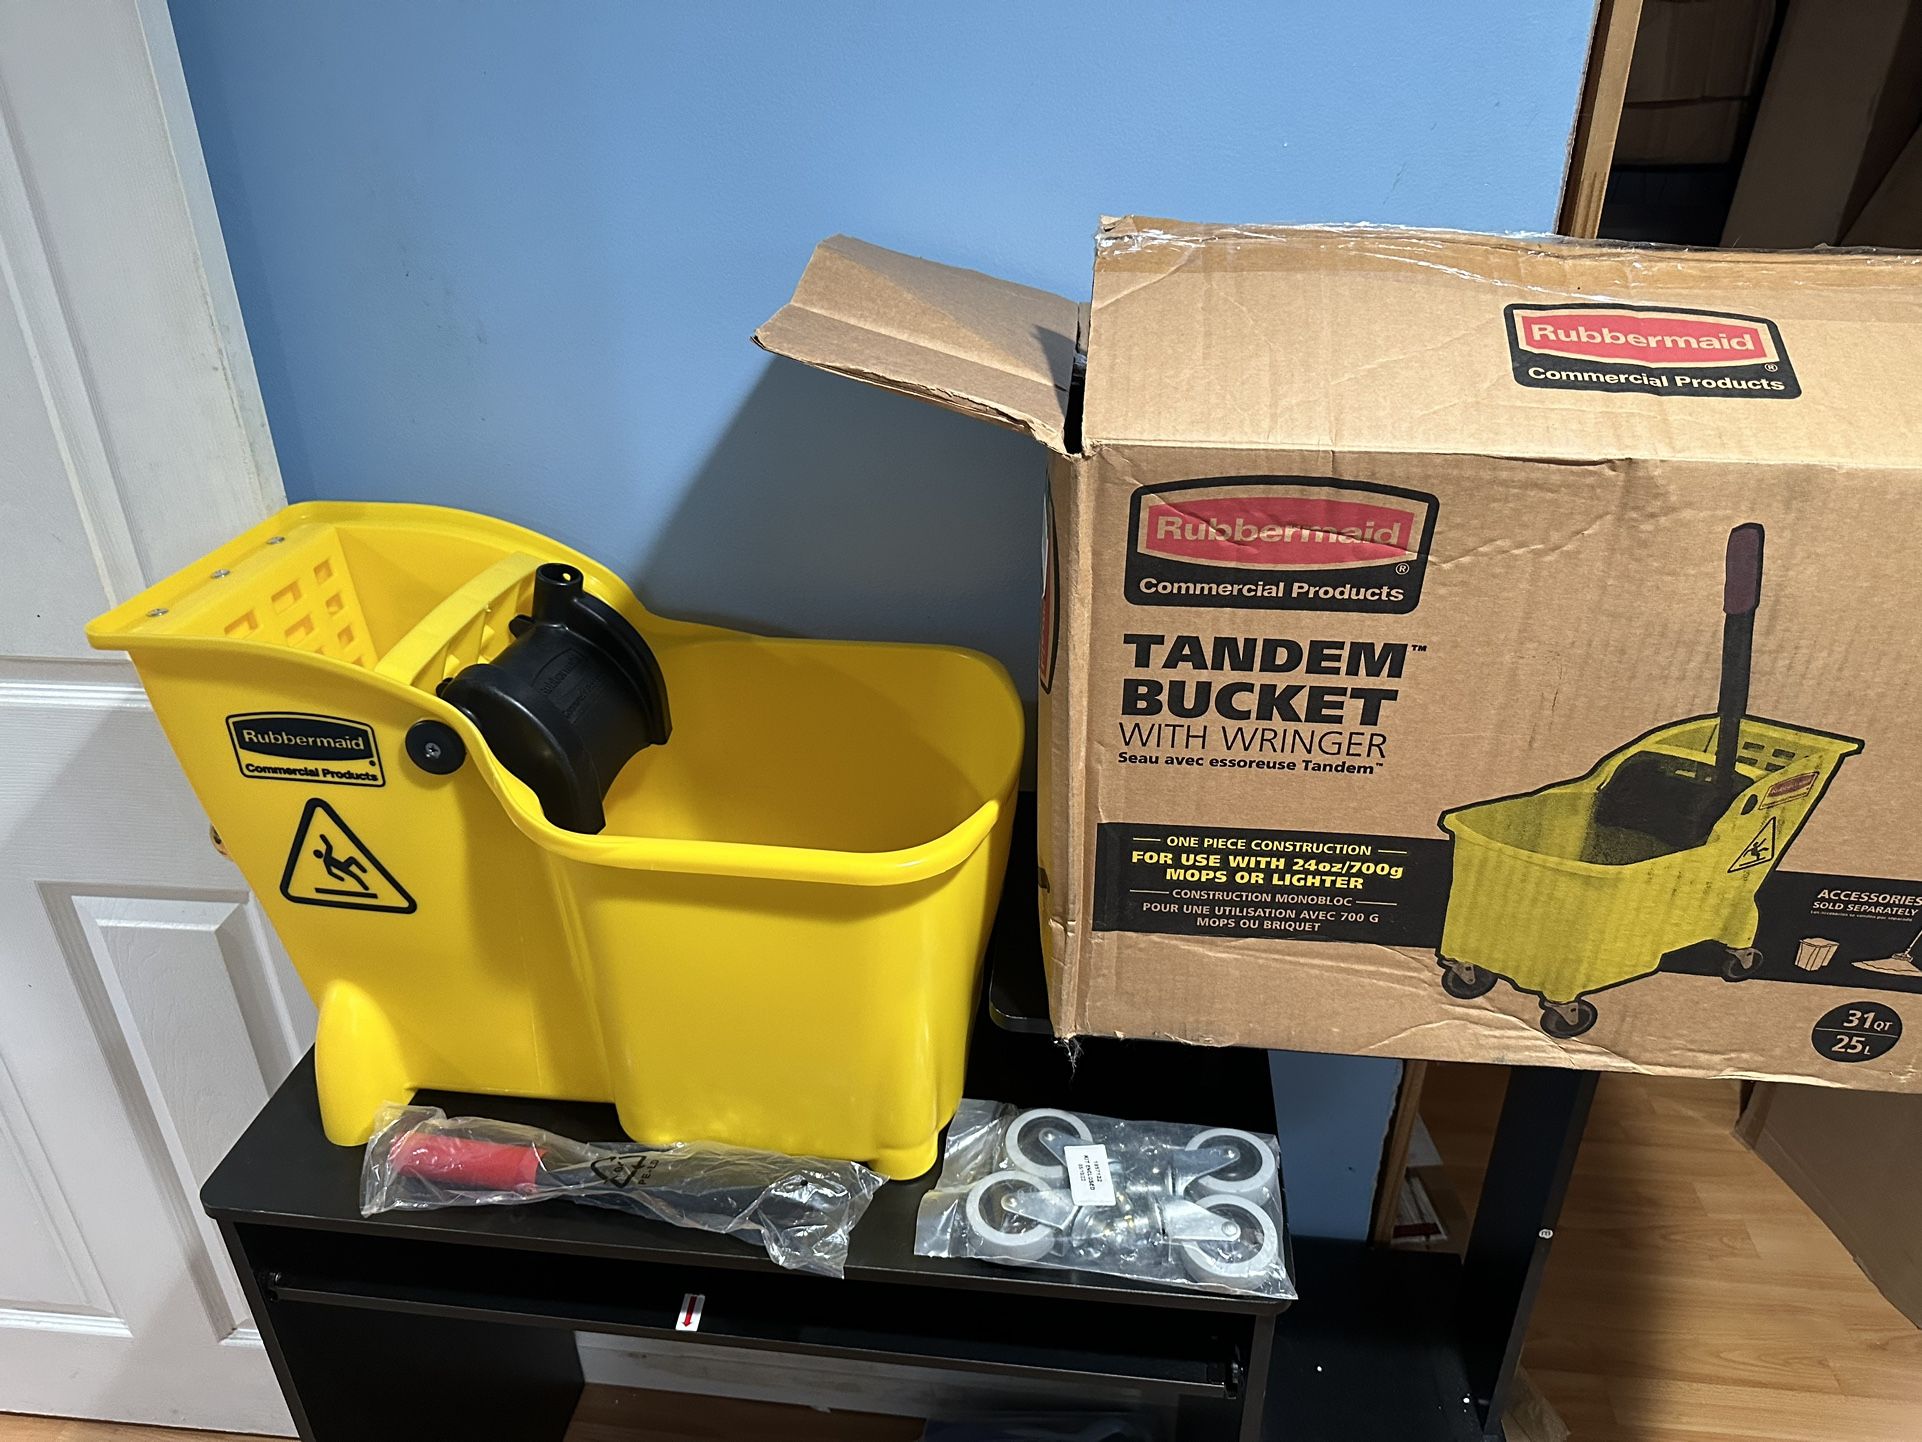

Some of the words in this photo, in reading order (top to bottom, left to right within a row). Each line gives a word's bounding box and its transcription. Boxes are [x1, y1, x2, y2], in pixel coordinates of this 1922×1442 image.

[1531, 324, 1755, 351] Rubbermaid
[1528, 367, 1668, 388] Commercial
[1674, 375, 1785, 391] Products
[1156, 515, 1400, 547] Rubbermaid
[1139, 577, 1284, 598] Commercial
[1291, 582, 1404, 601] Products
[1121, 678, 1399, 727] BUCKET
[242, 729, 365, 750] Rubbermaid
[1118, 722, 1207, 750] WITH
[1221, 726, 1387, 759] WRINGER
[1118, 752, 1159, 765] Seau
[1165, 756, 1204, 767] avec
[1209, 759, 1297, 771] essoreuse
[245, 763, 319, 777] Commercial
[321, 768, 379, 782] Products
[1167, 836, 1199, 848] ONE
[1203, 838, 1246, 850] PIECE
[1251, 840, 1372, 856] CONSTRUCTION
[1131, 851, 1173, 864] FOR
[1181, 853, 1221, 867] USE
[1228, 855, 1285, 870] WITH
[1292, 858, 1404, 879] 24oz/700g
[1166, 868, 1227, 883] MOPS
[1235, 871, 1264, 885] OR
[1272, 873, 1364, 889] LIGHTER
[1172, 889, 1271, 902] CONSTRUCTION
[1275, 893, 1353, 906] MONOBLOC
[1817, 889, 1922, 906] ACCESSORIES
[1143, 902, 1180, 913] POUR
[1183, 904, 1210, 915] UNE
[1214, 905, 1296, 919] UTILISATION
[1300, 910, 1337, 921] AVEC
[1340, 911, 1365, 922] 700
[1369, 913, 1379, 923] G
[1812, 901, 1844, 911] SOLD
[1846, 903, 1919, 916] SEPARATELY
[1196, 917, 1235, 928] MOPS
[1240, 919, 1259, 929] OU
[1263, 919, 1321, 932] BRIQUET
